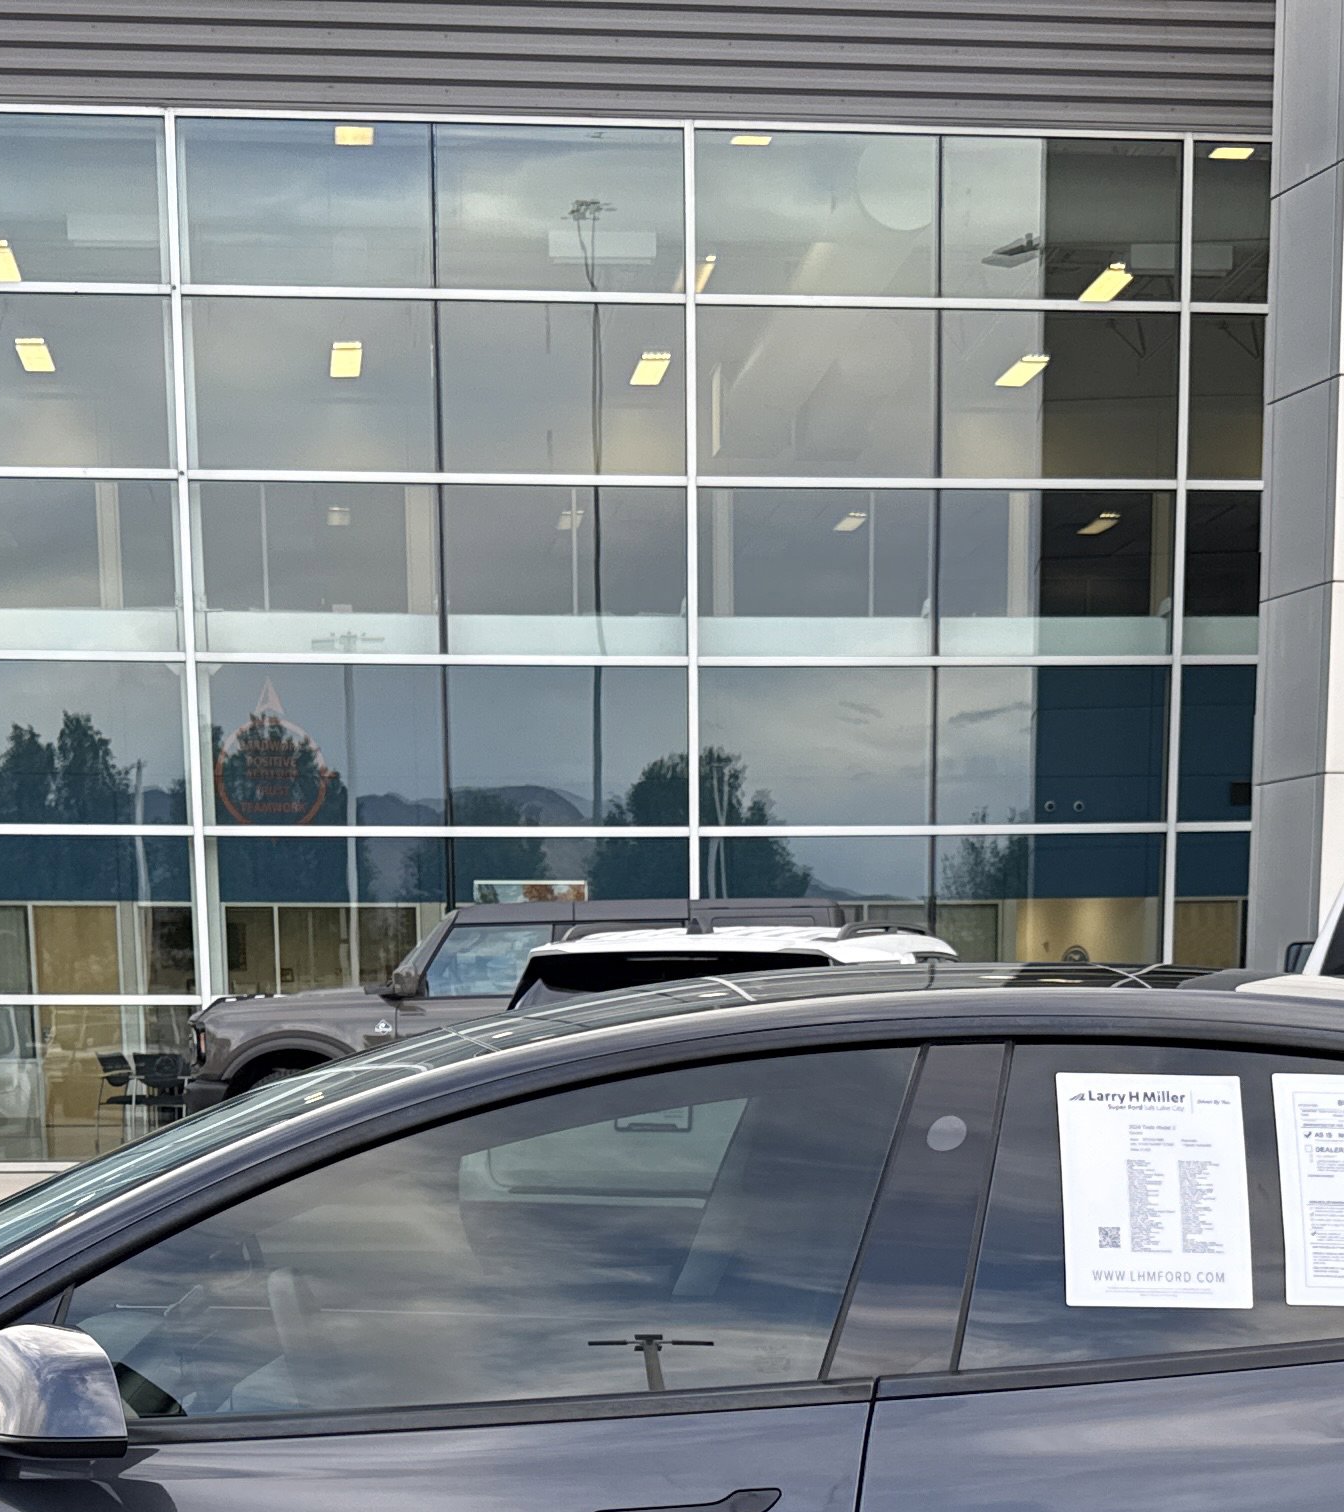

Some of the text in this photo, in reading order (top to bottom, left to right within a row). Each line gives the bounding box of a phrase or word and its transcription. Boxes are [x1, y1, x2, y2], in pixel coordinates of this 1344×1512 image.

[1088, 1090, 1186, 1104] Larry H Miller
